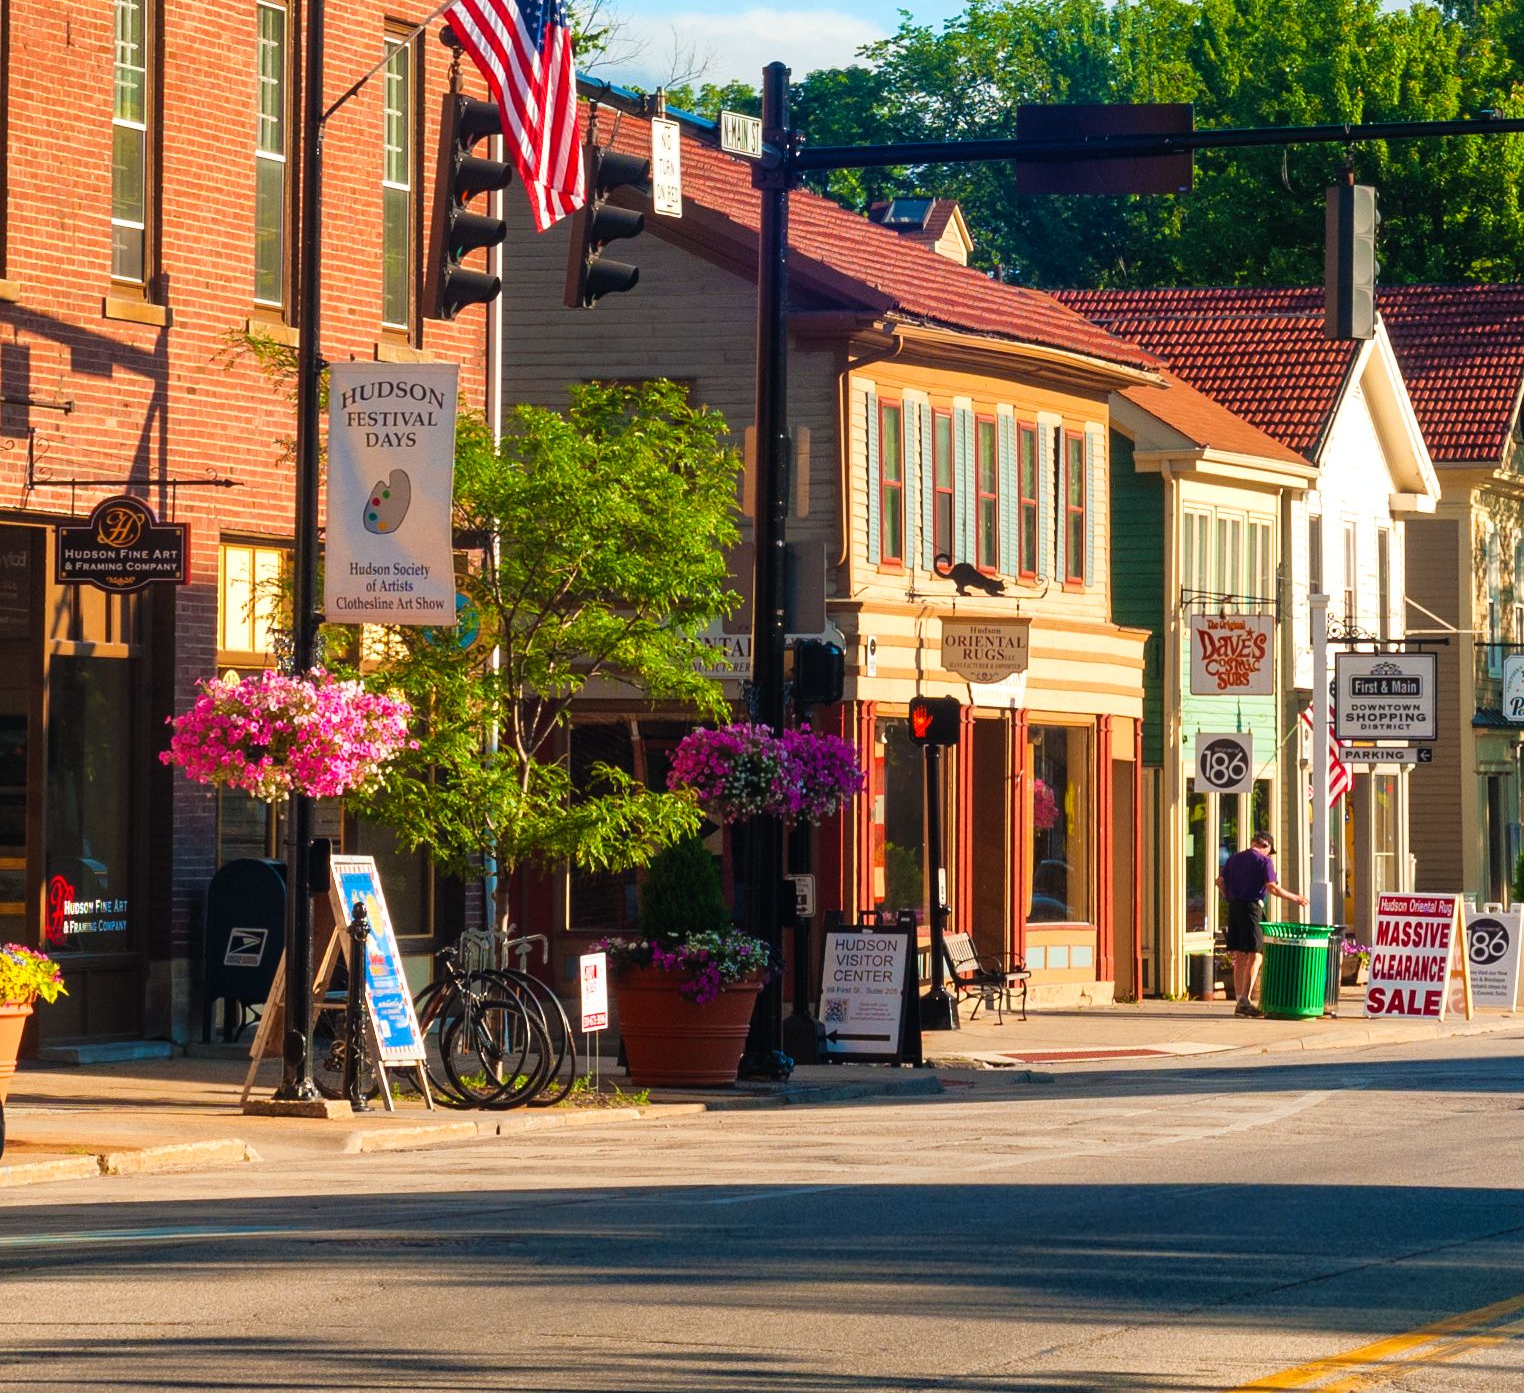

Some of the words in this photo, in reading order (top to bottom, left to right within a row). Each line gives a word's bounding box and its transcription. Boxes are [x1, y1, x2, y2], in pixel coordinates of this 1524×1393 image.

[752, 121, 760, 153] ST
[340, 381, 446, 410] HUDSON
[346, 411, 438, 427] FESTIVAL
[365, 432, 417, 448] DAYS
[64, 549, 116, 559] HUDSON
[120, 549, 149, 559] FINE
[152, 549, 178, 559] ART
[64, 561, 73, 571] &
[75, 562, 123, 571] FRAMING
[126, 562, 177, 571] COMPANY
[349, 562, 390, 576] Hudson
[392, 562, 431, 580] Society
[366, 579, 376, 592] of
[379, 580, 414, 592] Artists
[336, 597, 394, 610] Clothesline
[396, 597, 413, 610] Art
[415, 597, 445, 610] Show
[970, 626, 1001, 634] Hudson
[944, 634, 1026, 649] ORIENTAL
[962, 648, 1004, 661] RUGS
[1355, 680, 1377, 694] First
[1380, 680, 1388, 694] &
[1392, 680, 1417, 694] Main
[1351, 704, 1420, 712] DOWNTOWN
[1345, 713, 1427, 723] SHOPPING
[1345, 750, 1405, 760] PARKING
[1203, 750, 1247, 785] 186
[64, 900, 94, 915] HUDSON
[95, 899, 112, 913] FINE
[113, 898, 128, 913] ART
[1380, 898, 1408, 912] Hudson
[1409, 898, 1438, 913] Oriental
[1438, 900, 1453, 916] Rug
[1375, 920, 1451, 949] MASSIVE
[834, 939, 898, 952] HUDSON
[1466, 930, 1508, 962] 186
[836, 954, 894, 967] VISITOR
[1372, 953, 1447, 983] CLEARANCE
[833, 970, 893, 983] CENTER
[1366, 987, 1443, 1017] SALE
